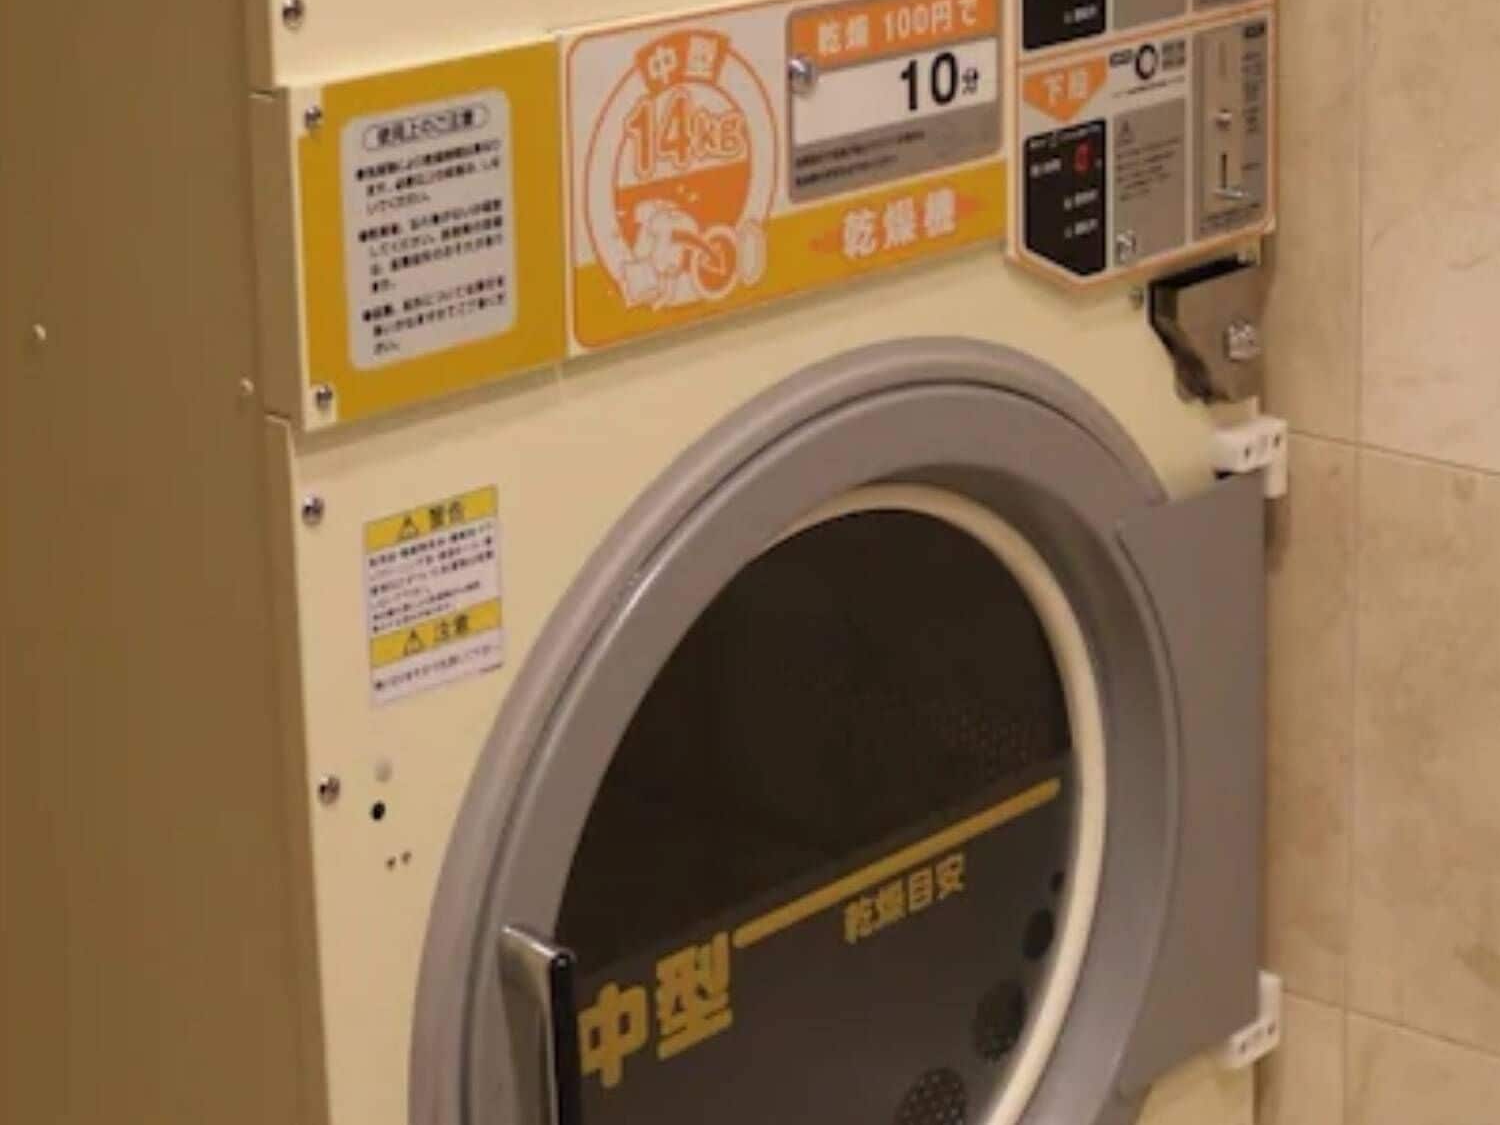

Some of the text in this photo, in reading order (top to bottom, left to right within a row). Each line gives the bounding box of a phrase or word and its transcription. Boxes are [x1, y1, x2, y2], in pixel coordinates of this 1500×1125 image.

[648, 35, 719, 84] 中型
[817, 13, 870, 55] 乾燥
[900, 51, 980, 112] 10分
[843, 188, 957, 258] 乾燥機
[844, 853, 966, 944] 乾燥目安
[577, 931, 733, 1088] 中型
